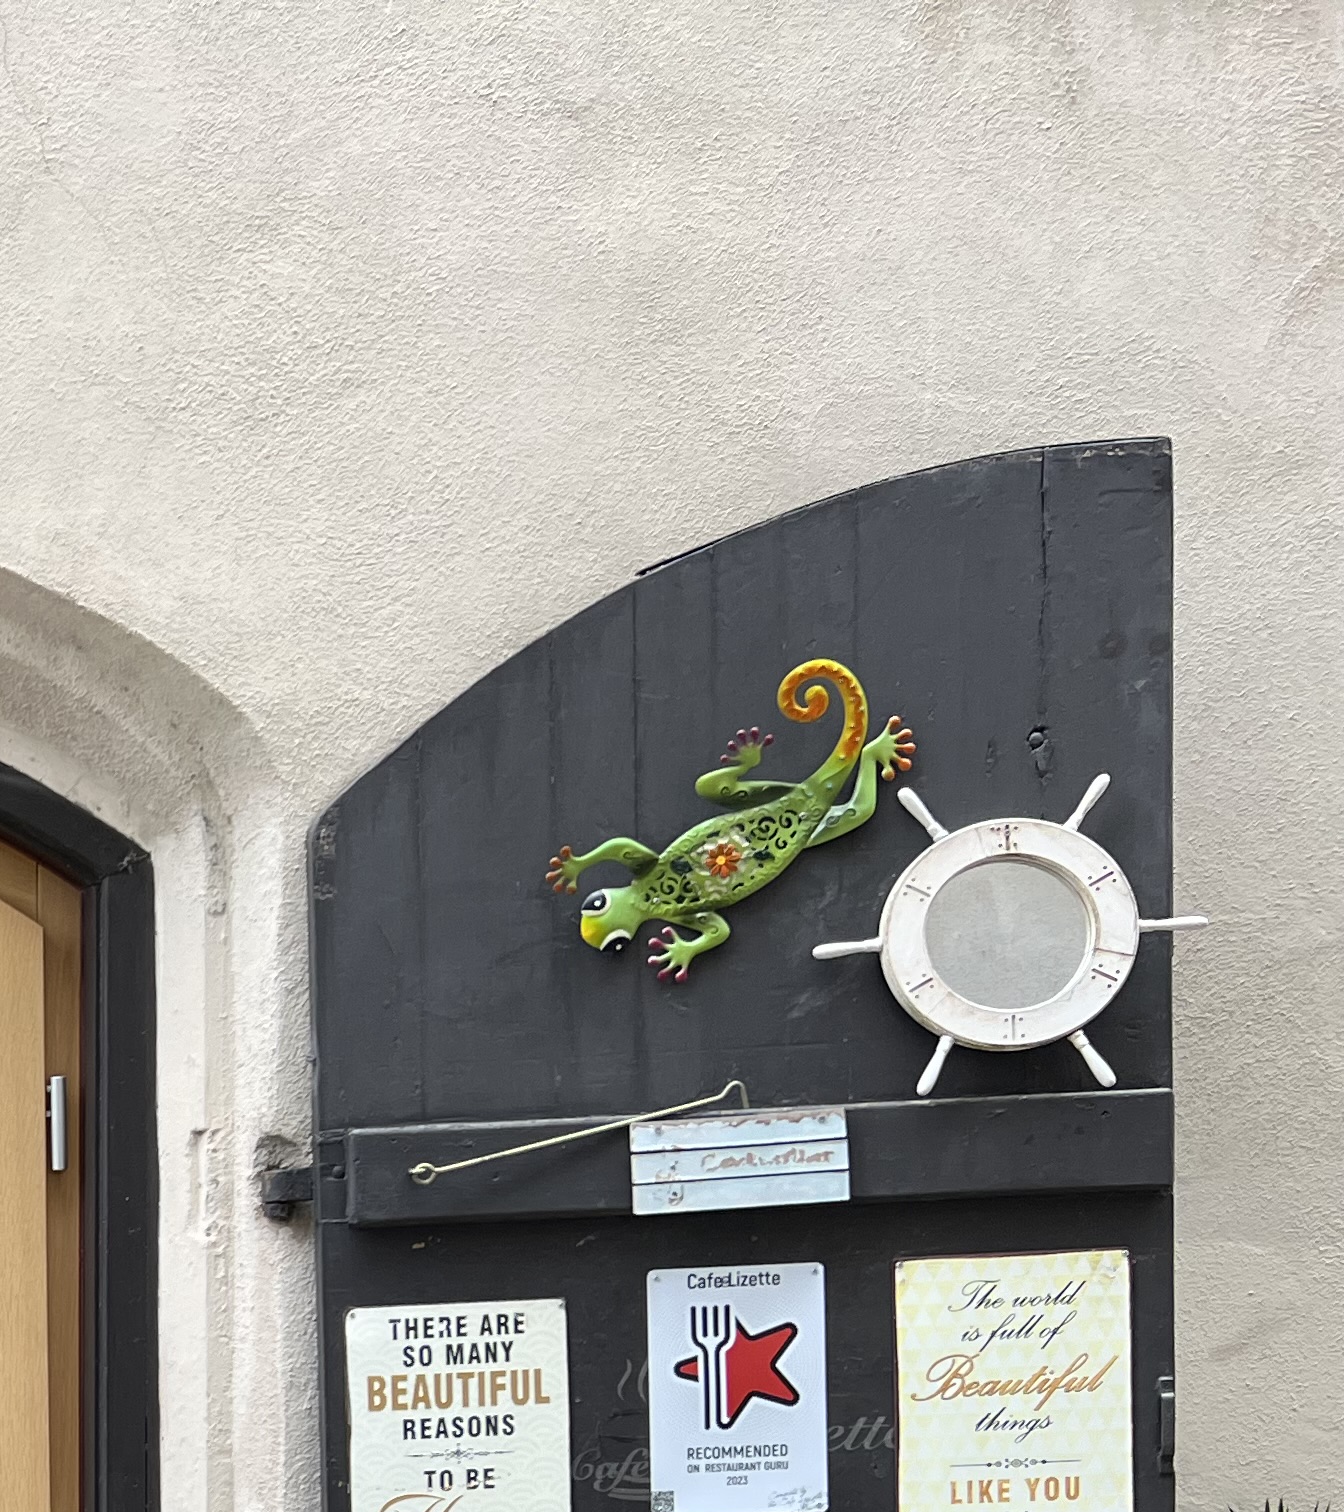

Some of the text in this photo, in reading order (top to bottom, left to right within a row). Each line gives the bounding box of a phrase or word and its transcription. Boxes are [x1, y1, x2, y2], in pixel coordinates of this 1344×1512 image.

[948, 1279, 1086, 1313] The world
[388, 1312, 526, 1340] THERE ARE
[961, 1311, 1077, 1353] is full of
[402, 1341, 514, 1367] SO MANY
[367, 1368, 550, 1412] BEAUTIFUL
[911, 1353, 1120, 1411] Beautiful
[402, 1414, 515, 1441] REASONS
[975, 1407, 1053, 1444] things
[687, 1444, 788, 1461] RECOMMENDED
[424, 1468, 495, 1491] TO BE
[687, 1461, 789, 1473] ON RESTAURANT GURU
[726, 1476, 748, 1486] 2023
[950, 1476, 1081, 1504] LIKE YOU
